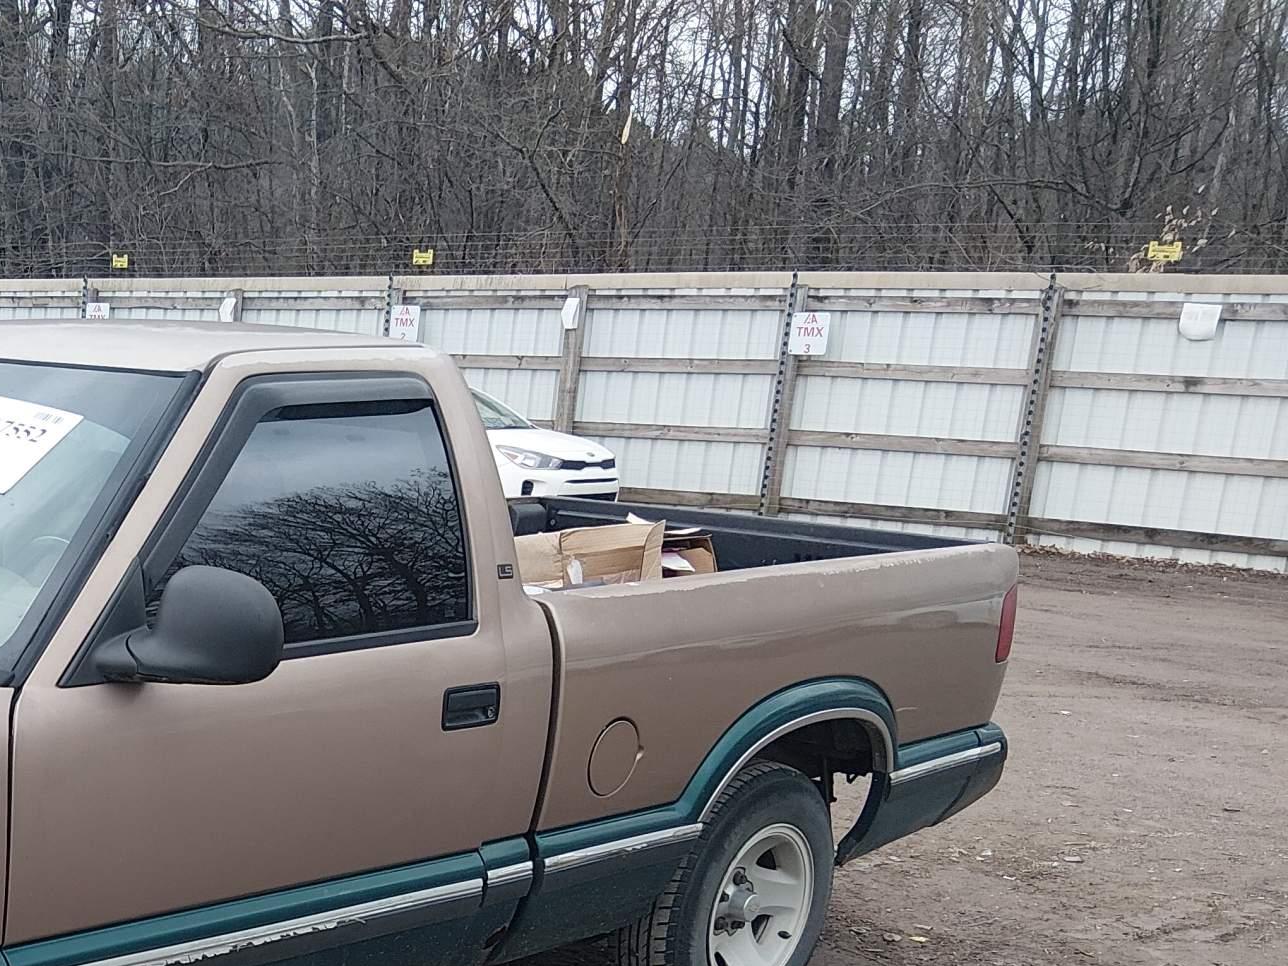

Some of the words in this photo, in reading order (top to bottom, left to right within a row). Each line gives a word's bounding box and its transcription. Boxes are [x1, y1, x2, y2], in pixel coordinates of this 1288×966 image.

[394, 317, 415, 328] TMX
[796, 326, 825, 338] TMX
[803, 343, 811, 354] 3
[498, 565, 513, 577] LS
